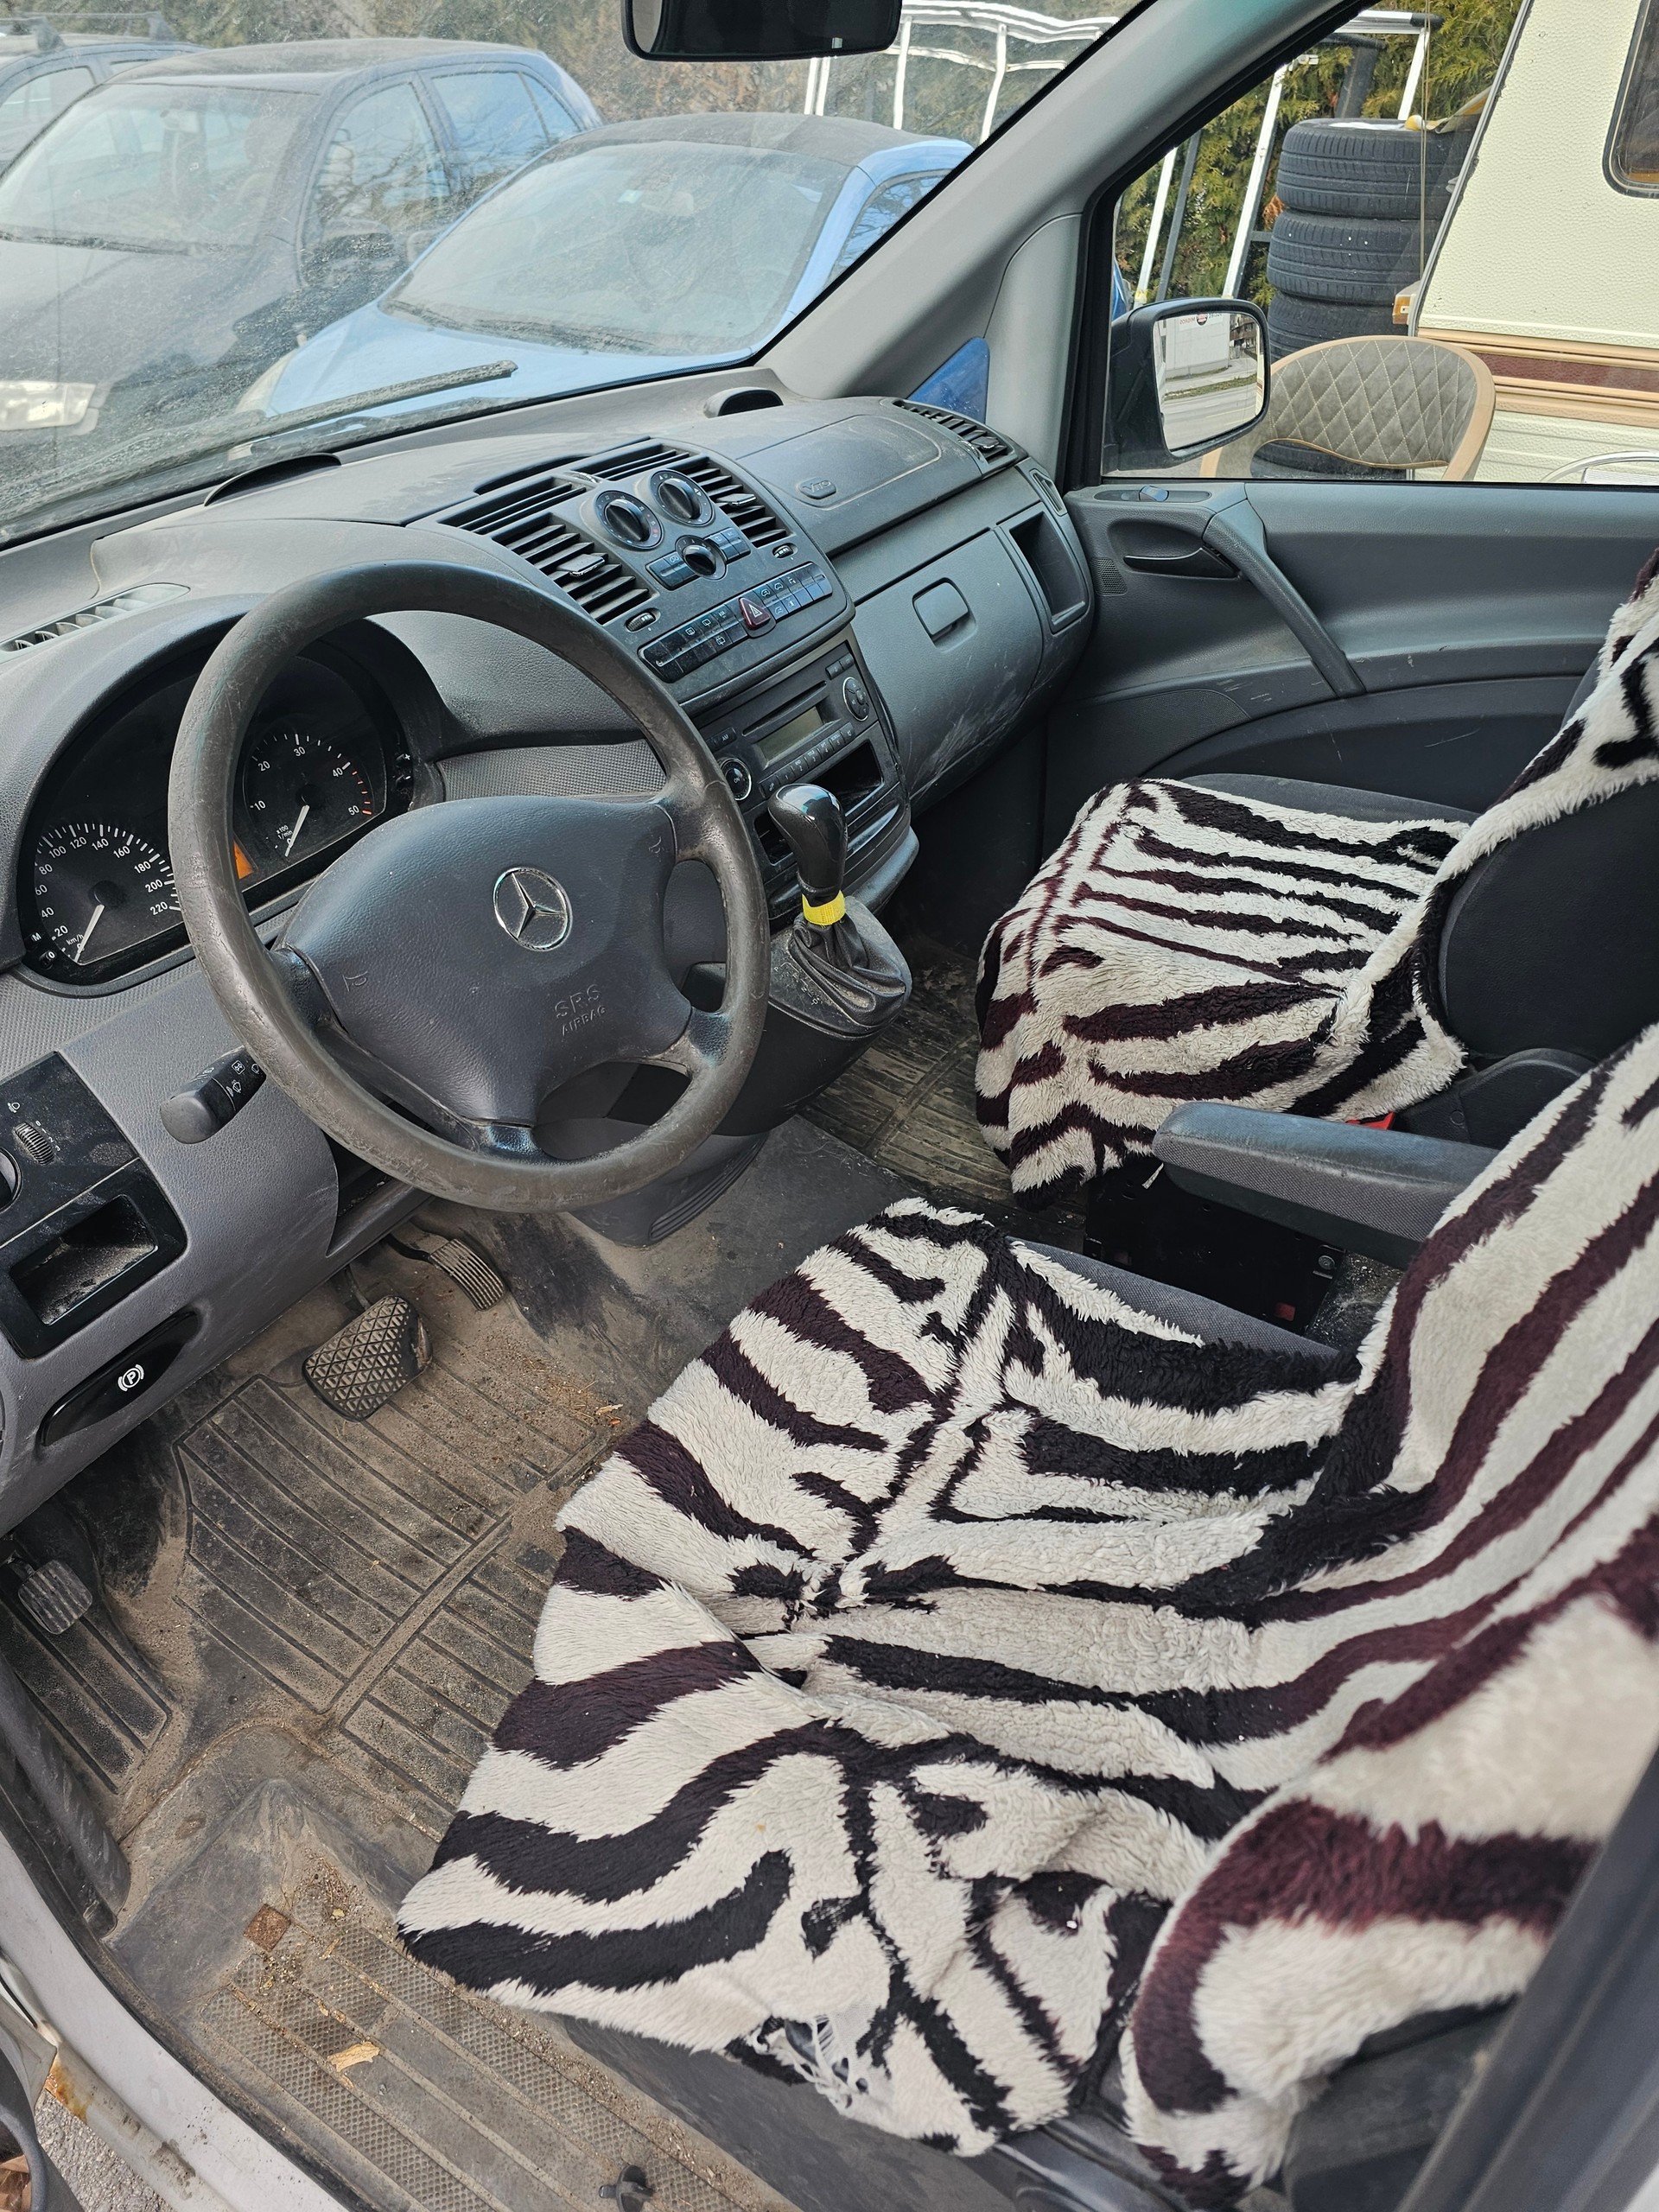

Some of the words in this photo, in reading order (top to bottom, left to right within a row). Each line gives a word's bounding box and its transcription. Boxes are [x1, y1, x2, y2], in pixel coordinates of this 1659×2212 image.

[294, 747, 306, 757] 30
[258, 760, 270, 772] 20
[333, 767, 343, 778] 40
[254, 800, 266, 810] 10
[348, 804, 359, 815] 50
[70, 836, 87, 849] 120
[92, 838, 109, 851] 140
[48, 845, 67, 859] 100
[113, 845, 130, 858] 160
[39, 864, 53, 875] 80
[134, 861, 151, 874] 180
[35, 884, 48, 896] 60
[145, 879, 163, 893] 200
[41, 906, 54, 918] 40
[150, 901, 168, 916] 220
[54, 925, 68, 938] 20
[66, 933, 84, 945] km/h
[555, 984, 601, 1018] SRS
[562, 1005, 605, 1036] AIRBAG
